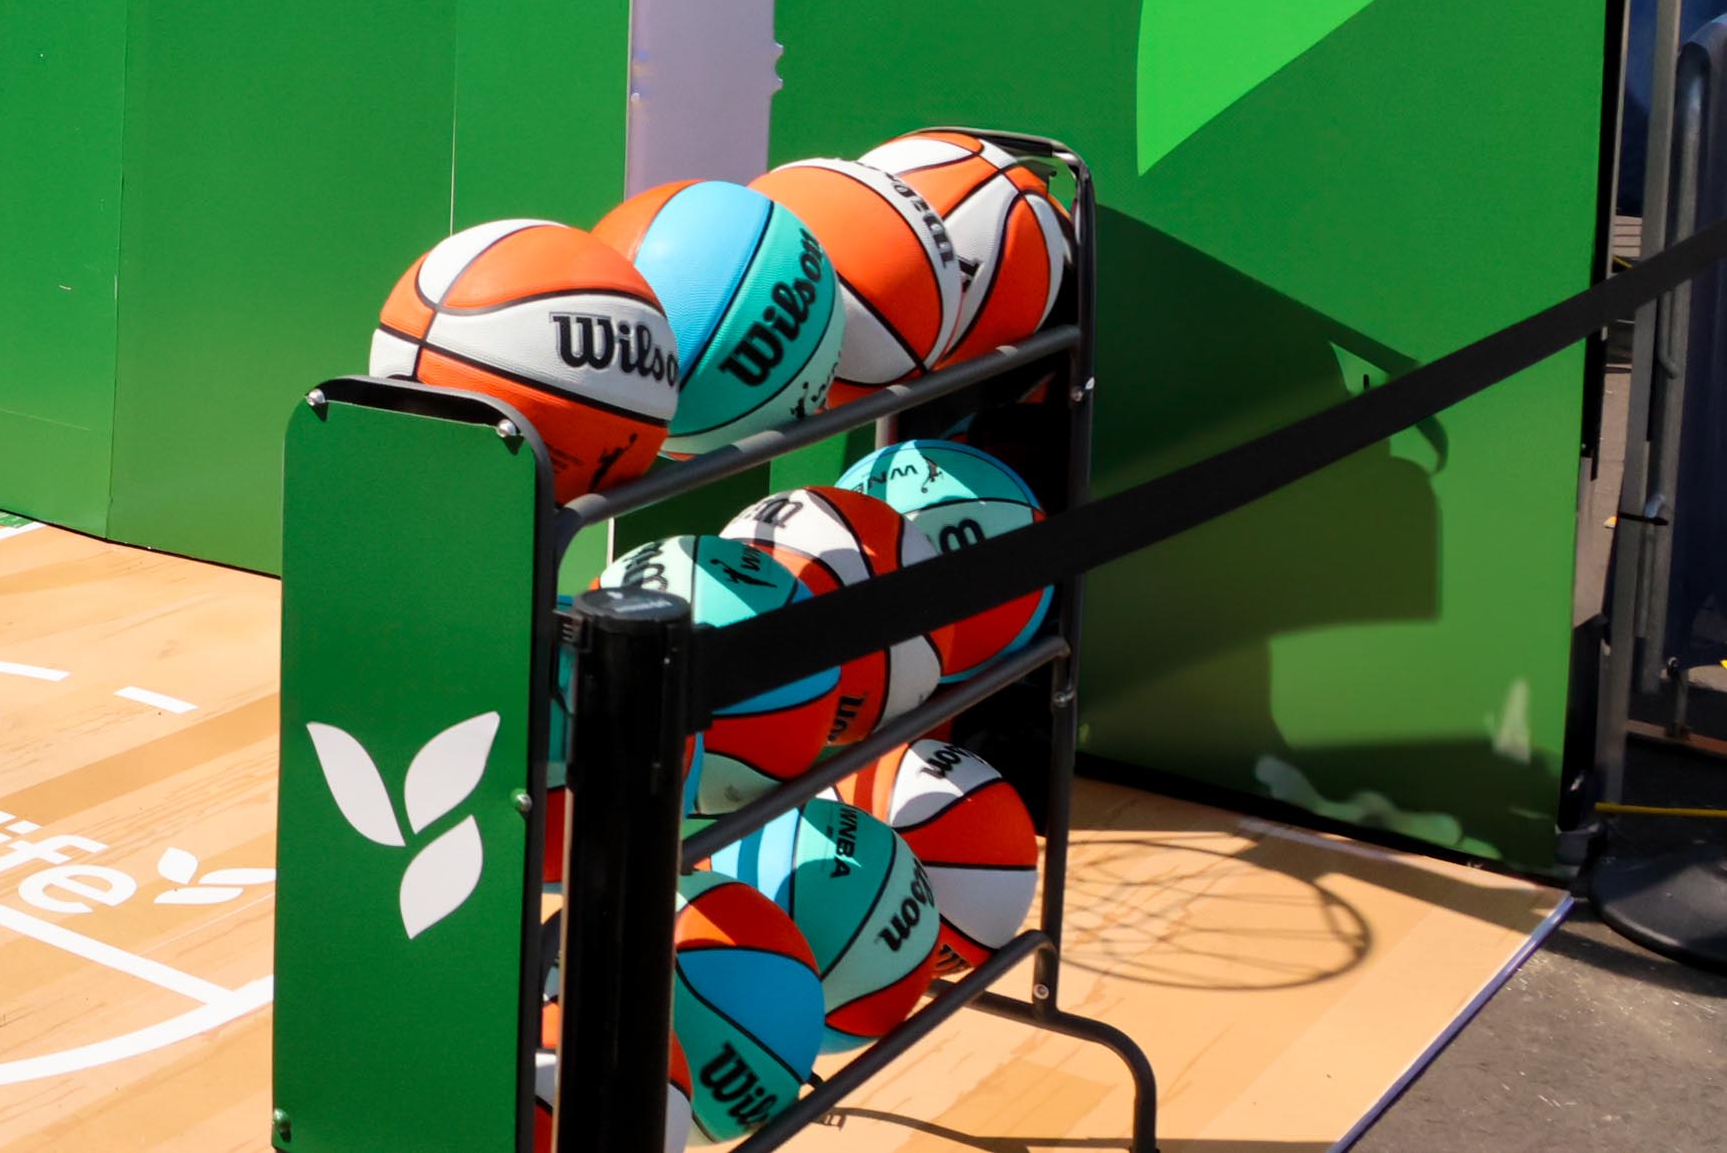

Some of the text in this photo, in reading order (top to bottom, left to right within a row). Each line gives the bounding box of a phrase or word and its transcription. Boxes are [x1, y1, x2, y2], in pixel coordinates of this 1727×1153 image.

[717, 228, 823, 388] Wilson
[550, 312, 678, 387] Wilso
[830, 807, 858, 879] WNBA
